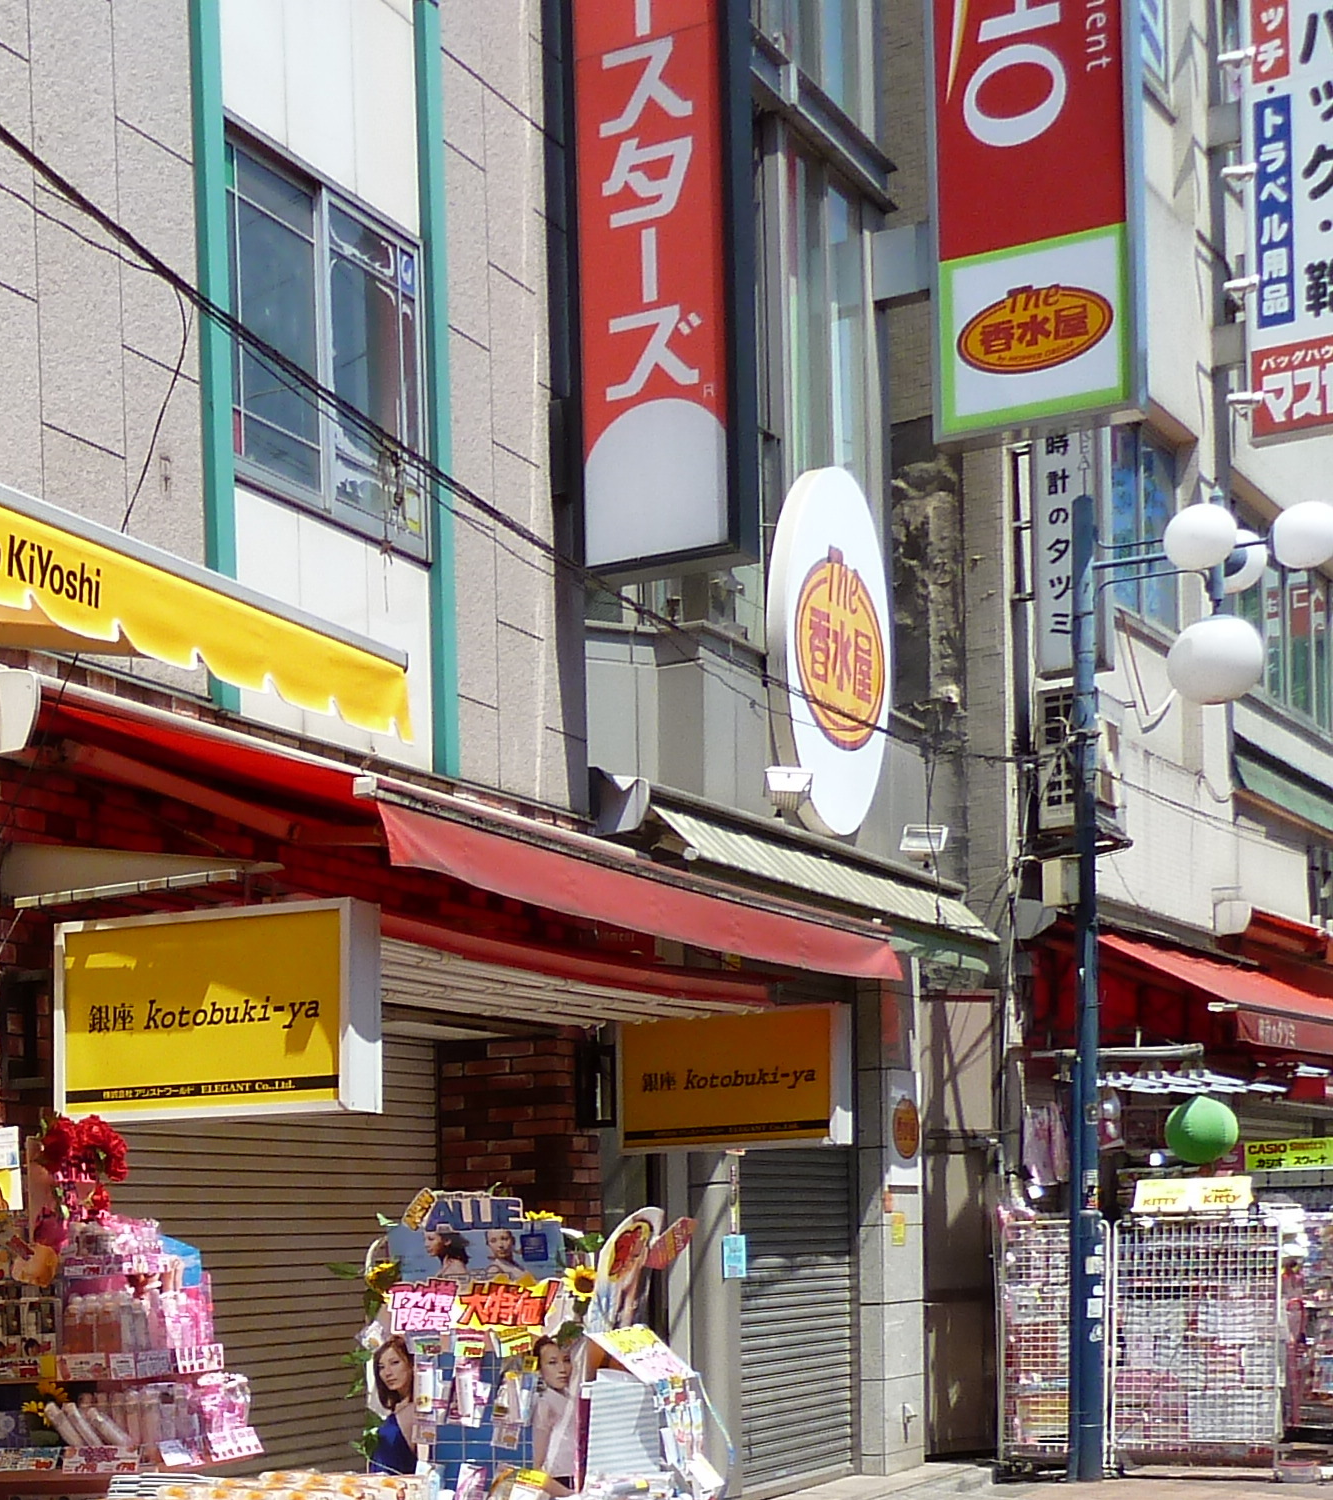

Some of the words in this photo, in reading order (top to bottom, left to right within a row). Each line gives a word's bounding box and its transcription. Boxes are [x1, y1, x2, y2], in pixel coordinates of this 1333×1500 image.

[979, 304, 1091, 356] 香水屋
[1044, 432, 1073, 637] 時計のタツミ
[7, 543, 102, 611] KiYoshi
[88, 1003, 134, 1034] 銀座
[143, 995, 320, 1031] kotobuki-ya
[200, 1082, 252, 1094] ELEGANT
[683, 1066, 817, 1090] kotobuki-ya
[1248, 1143, 1287, 1155] CASIO
[425, 1197, 524, 1232] ALLIE
